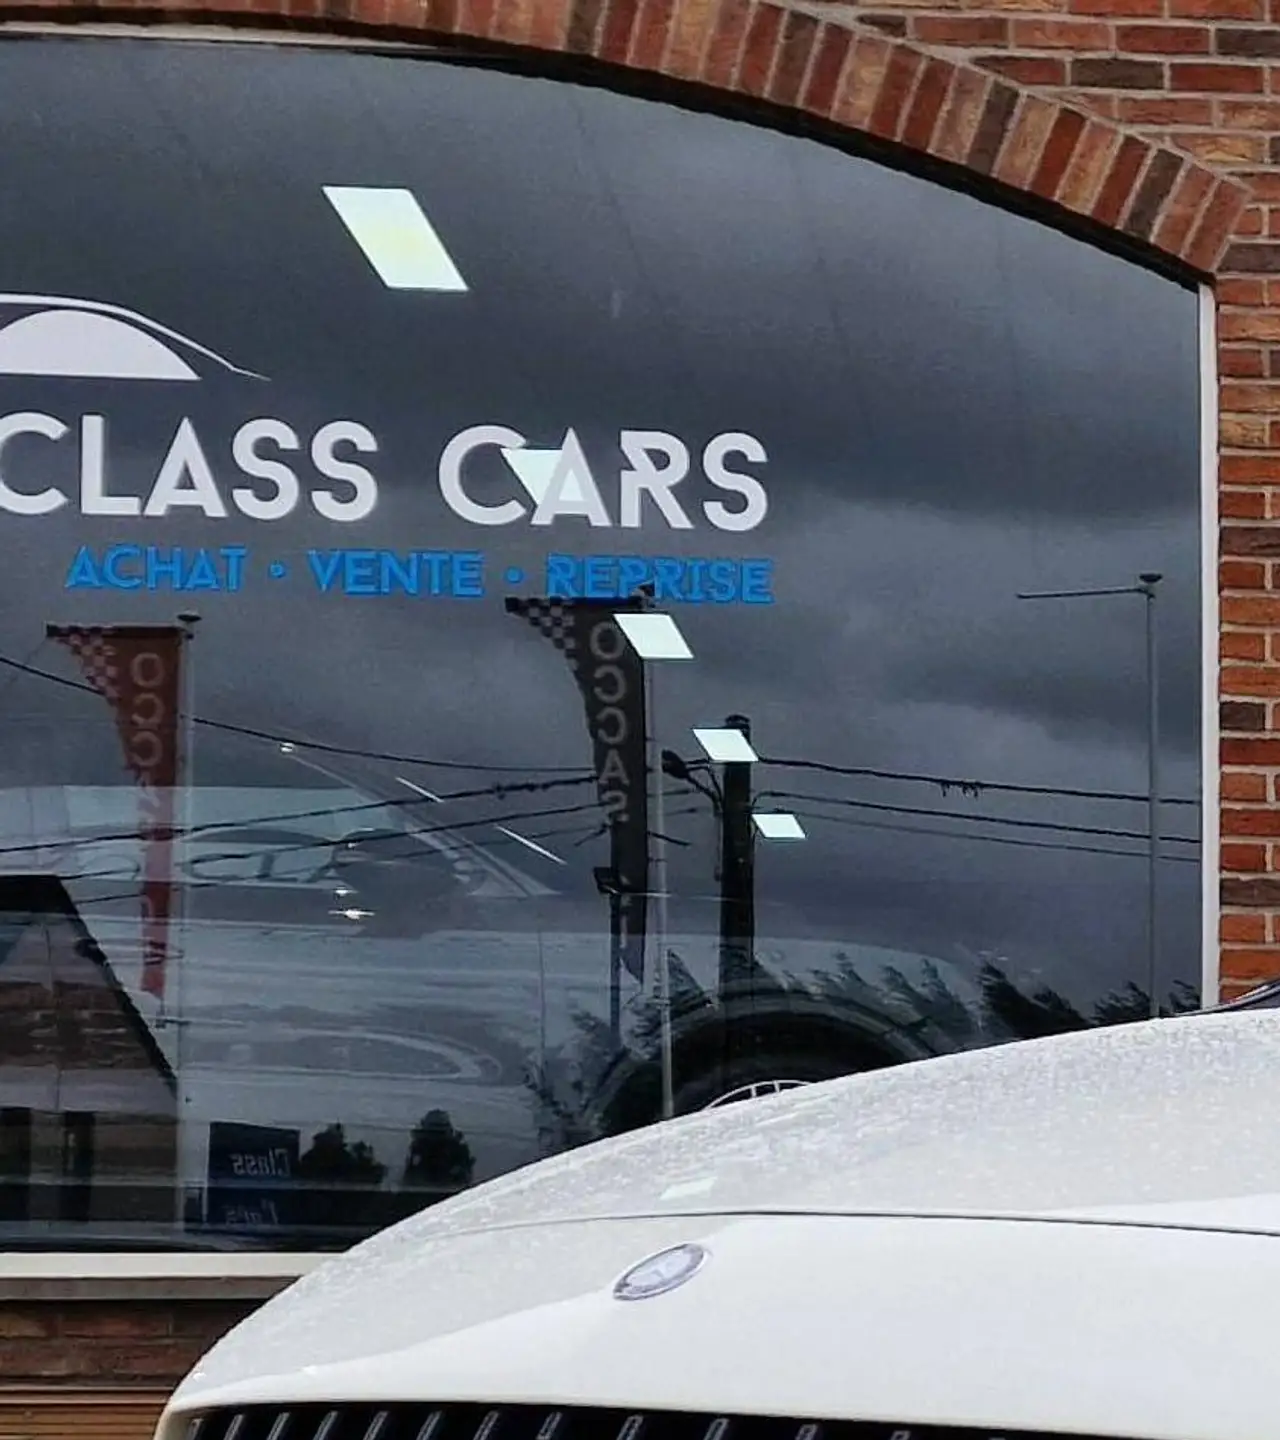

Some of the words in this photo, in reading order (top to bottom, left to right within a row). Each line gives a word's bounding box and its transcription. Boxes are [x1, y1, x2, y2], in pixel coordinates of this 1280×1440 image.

[0, 411, 379, 522] CLASS
[438, 425, 768, 532] CARS
[64, 543, 249, 591] ACHAT
[308, 548, 485, 598] VENTE
[546, 553, 775, 605] REPRISE
